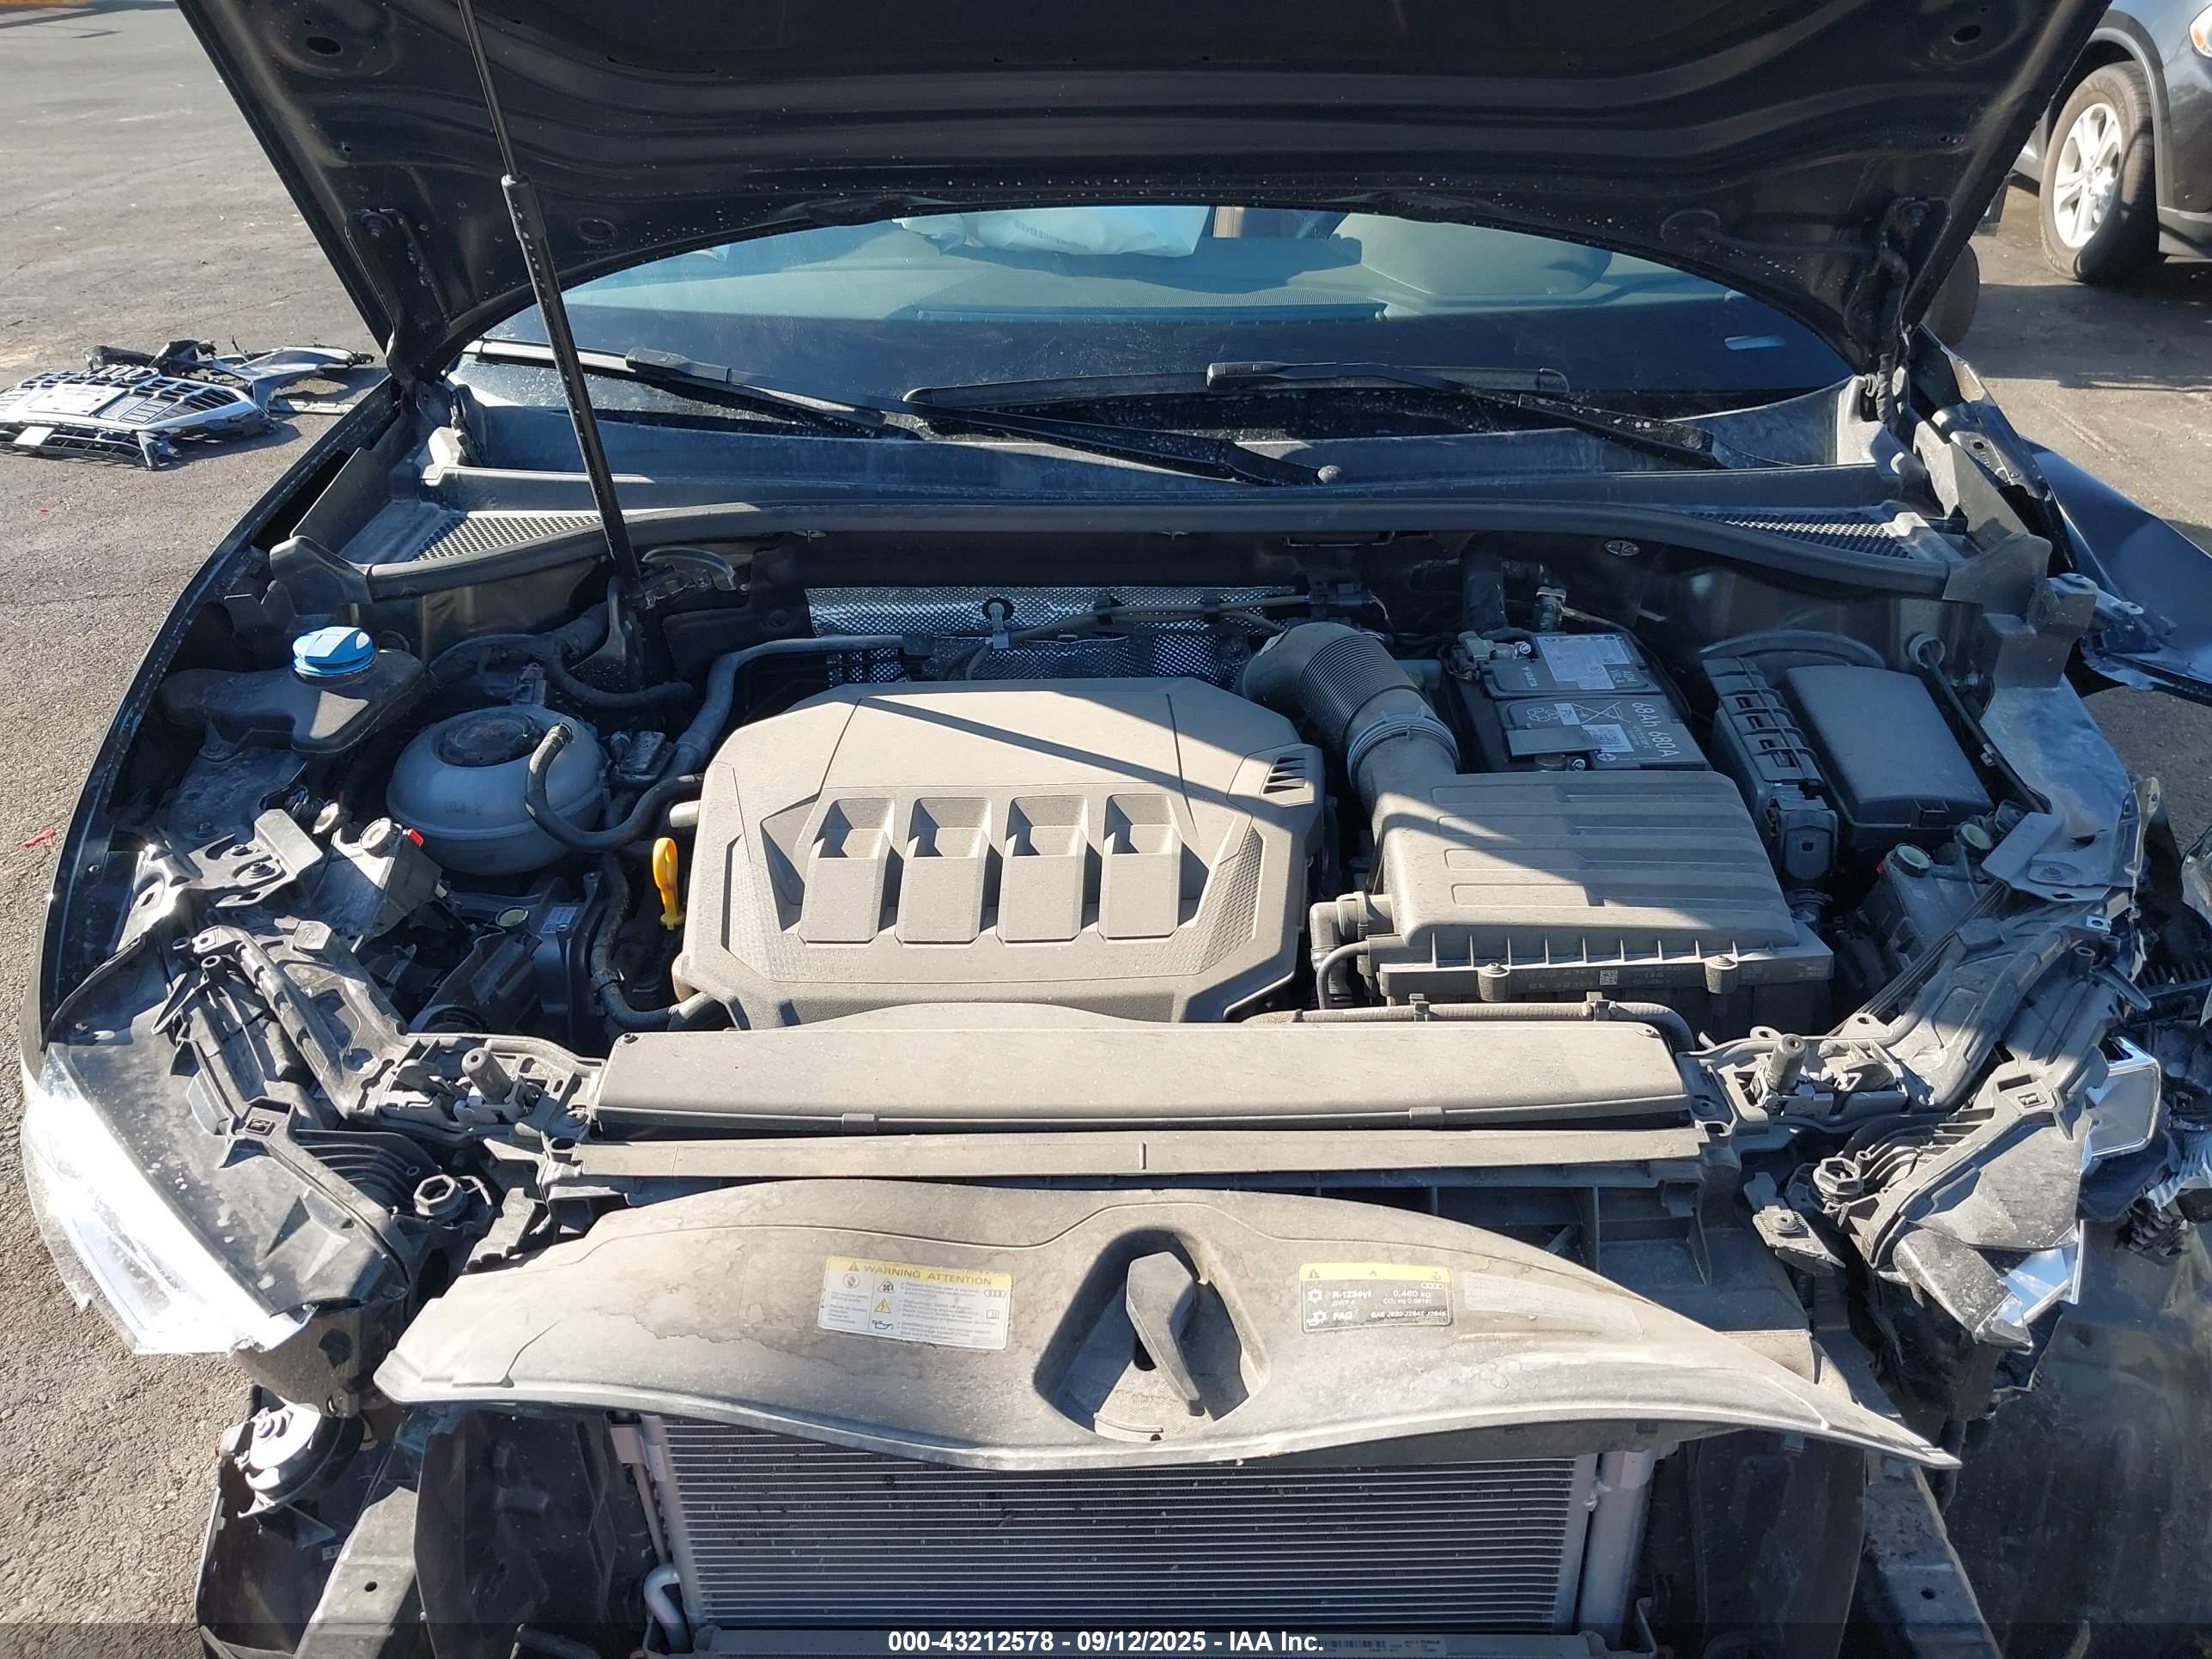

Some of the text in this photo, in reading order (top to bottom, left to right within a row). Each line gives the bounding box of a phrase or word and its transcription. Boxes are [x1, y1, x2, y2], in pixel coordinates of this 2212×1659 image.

[1632, 702, 1659, 729] 68Ah
[1648, 730, 1680, 758] 680A
[864, 1264, 992, 1285] WARNING ATTENTION
[1333, 1310, 1353, 1321] PAG
